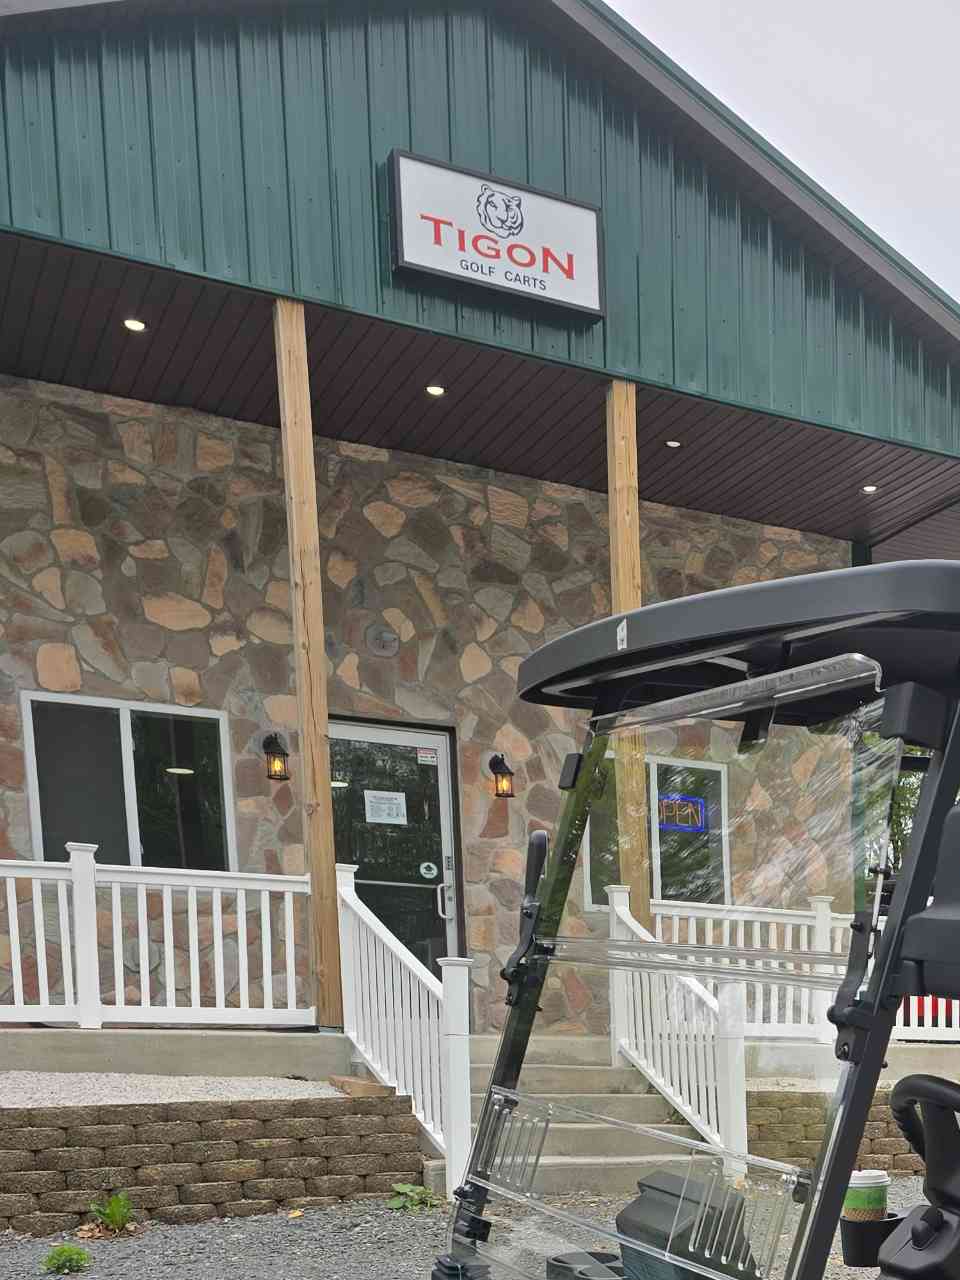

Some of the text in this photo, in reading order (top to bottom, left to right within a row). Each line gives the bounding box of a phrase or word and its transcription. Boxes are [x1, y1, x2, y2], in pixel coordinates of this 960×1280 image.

[419, 213, 575, 281] TIGON
[459, 258, 547, 291] GOLF CARTS
